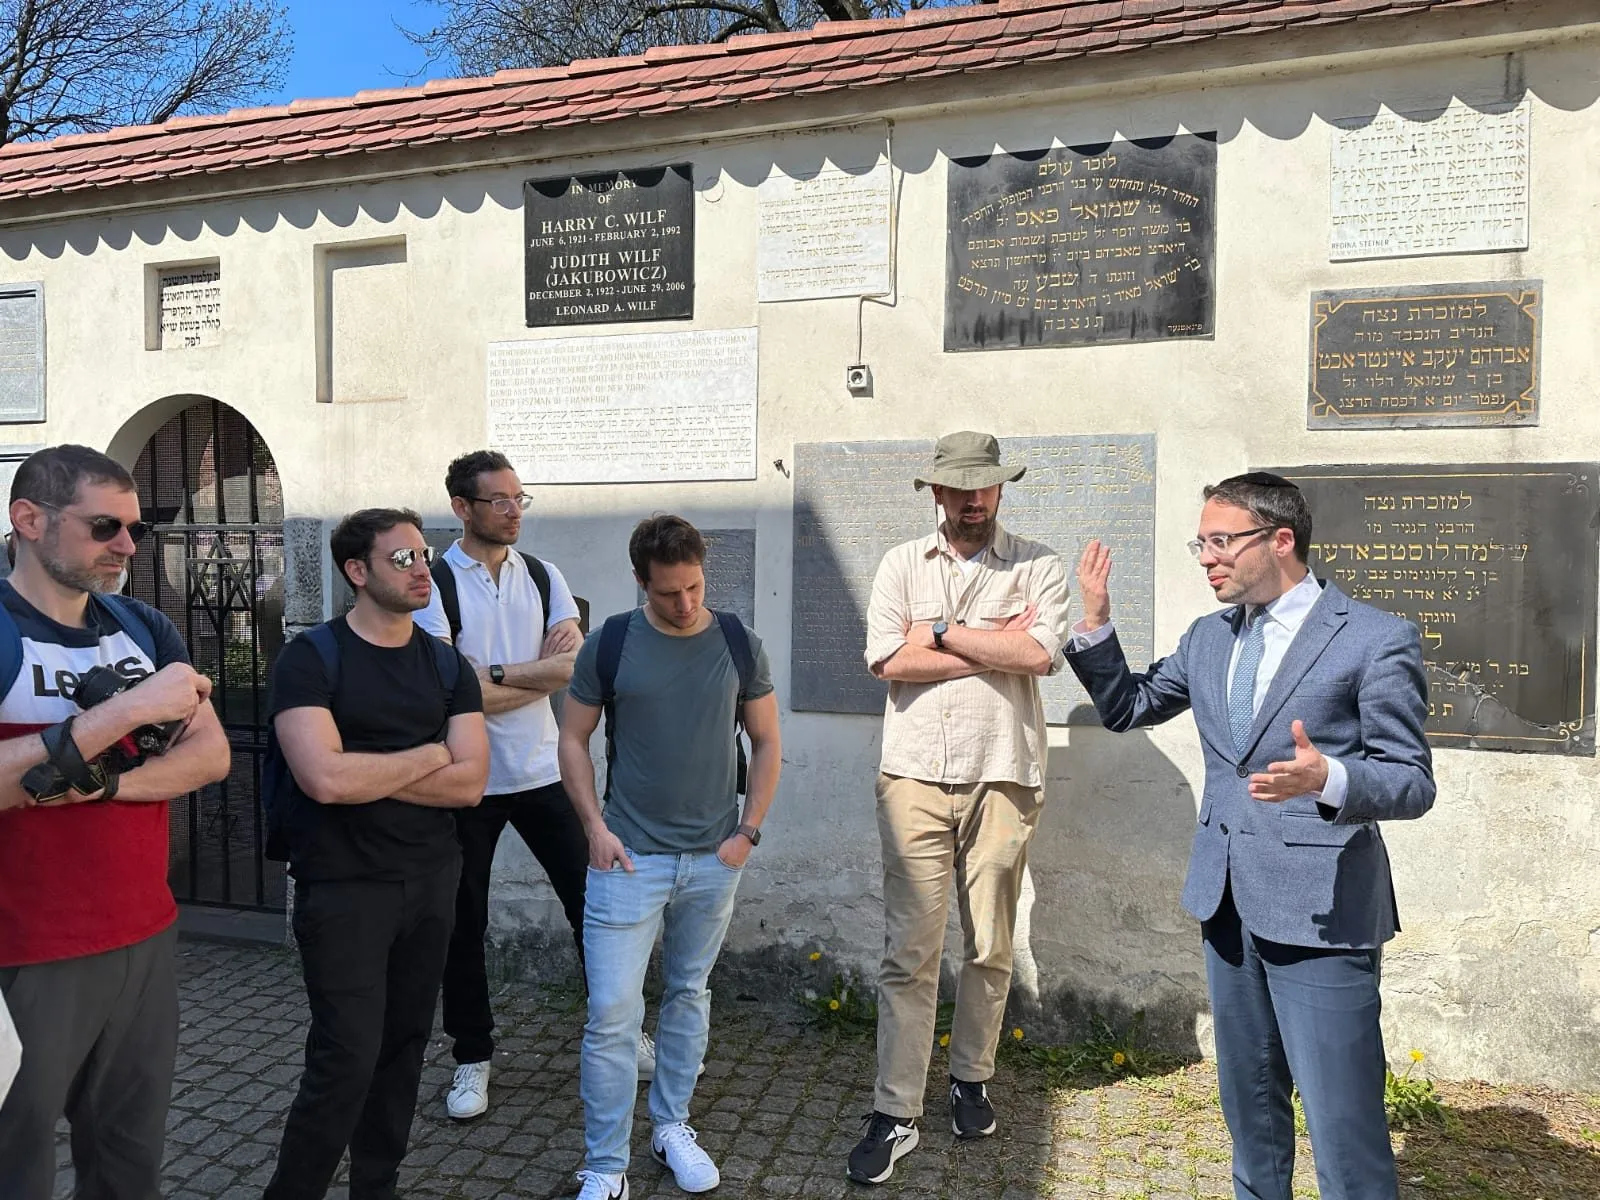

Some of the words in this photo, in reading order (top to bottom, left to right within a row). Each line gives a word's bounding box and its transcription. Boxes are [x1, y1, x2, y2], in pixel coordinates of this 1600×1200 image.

[1038, 157, 1073, 176] עולם
[1082, 152, 1117, 171] לזכר
[571, 184, 583, 194] IN
[588, 178, 637, 194] MEMORY
[597, 194, 612, 204] OF
[1069, 199, 1140, 220] שמואל
[541, 216, 598, 234] HARRY
[604, 214, 620, 229] C.
[623, 209, 667, 226] WILF
[1141, 224, 1170, 236] משה
[530, 237, 555, 248] JUNE
[568, 234, 587, 245] 1921
[594, 228, 648, 242] FEBRUARY
[661, 225, 681, 236] 1992
[1009, 234, 1046, 247] נשמות
[550, 252, 610, 270] JUDITH
[617, 248, 662, 264] WILF
[546, 265, 667, 288] (JAKUBOWICZ)
[1143, 267, 1181, 292] ישראל
[529, 288, 582, 300] DECEMBER
[596, 286, 615, 296] 1922
[621, 284, 647, 294] JUNE
[651, 283, 664, 293] 29,
[666, 281, 686, 291] 2006
[555, 303, 610, 316] LEONARD
[614, 303, 625, 312] A.
[627, 300, 657, 311] WILF
[1362, 308, 1398, 323] נצח
[1407, 298, 1487, 321] למזכרת
[1448, 327, 1494, 339] הנדיב
[1421, 348, 1465, 369] יעקב
[1470, 346, 1530, 364] אברהם
[1403, 370, 1455, 387] שמואל
[1486, 373, 1502, 388] בן
[1401, 490, 1472, 510] למזכרת
[1391, 523, 1427, 534] הנגיד
[1434, 522, 1475, 534] הרבני
[1364, 570, 1388, 580] צבי
[1393, 566, 1457, 584] קלונימוס
[1402, 589, 1435, 600] אדר
